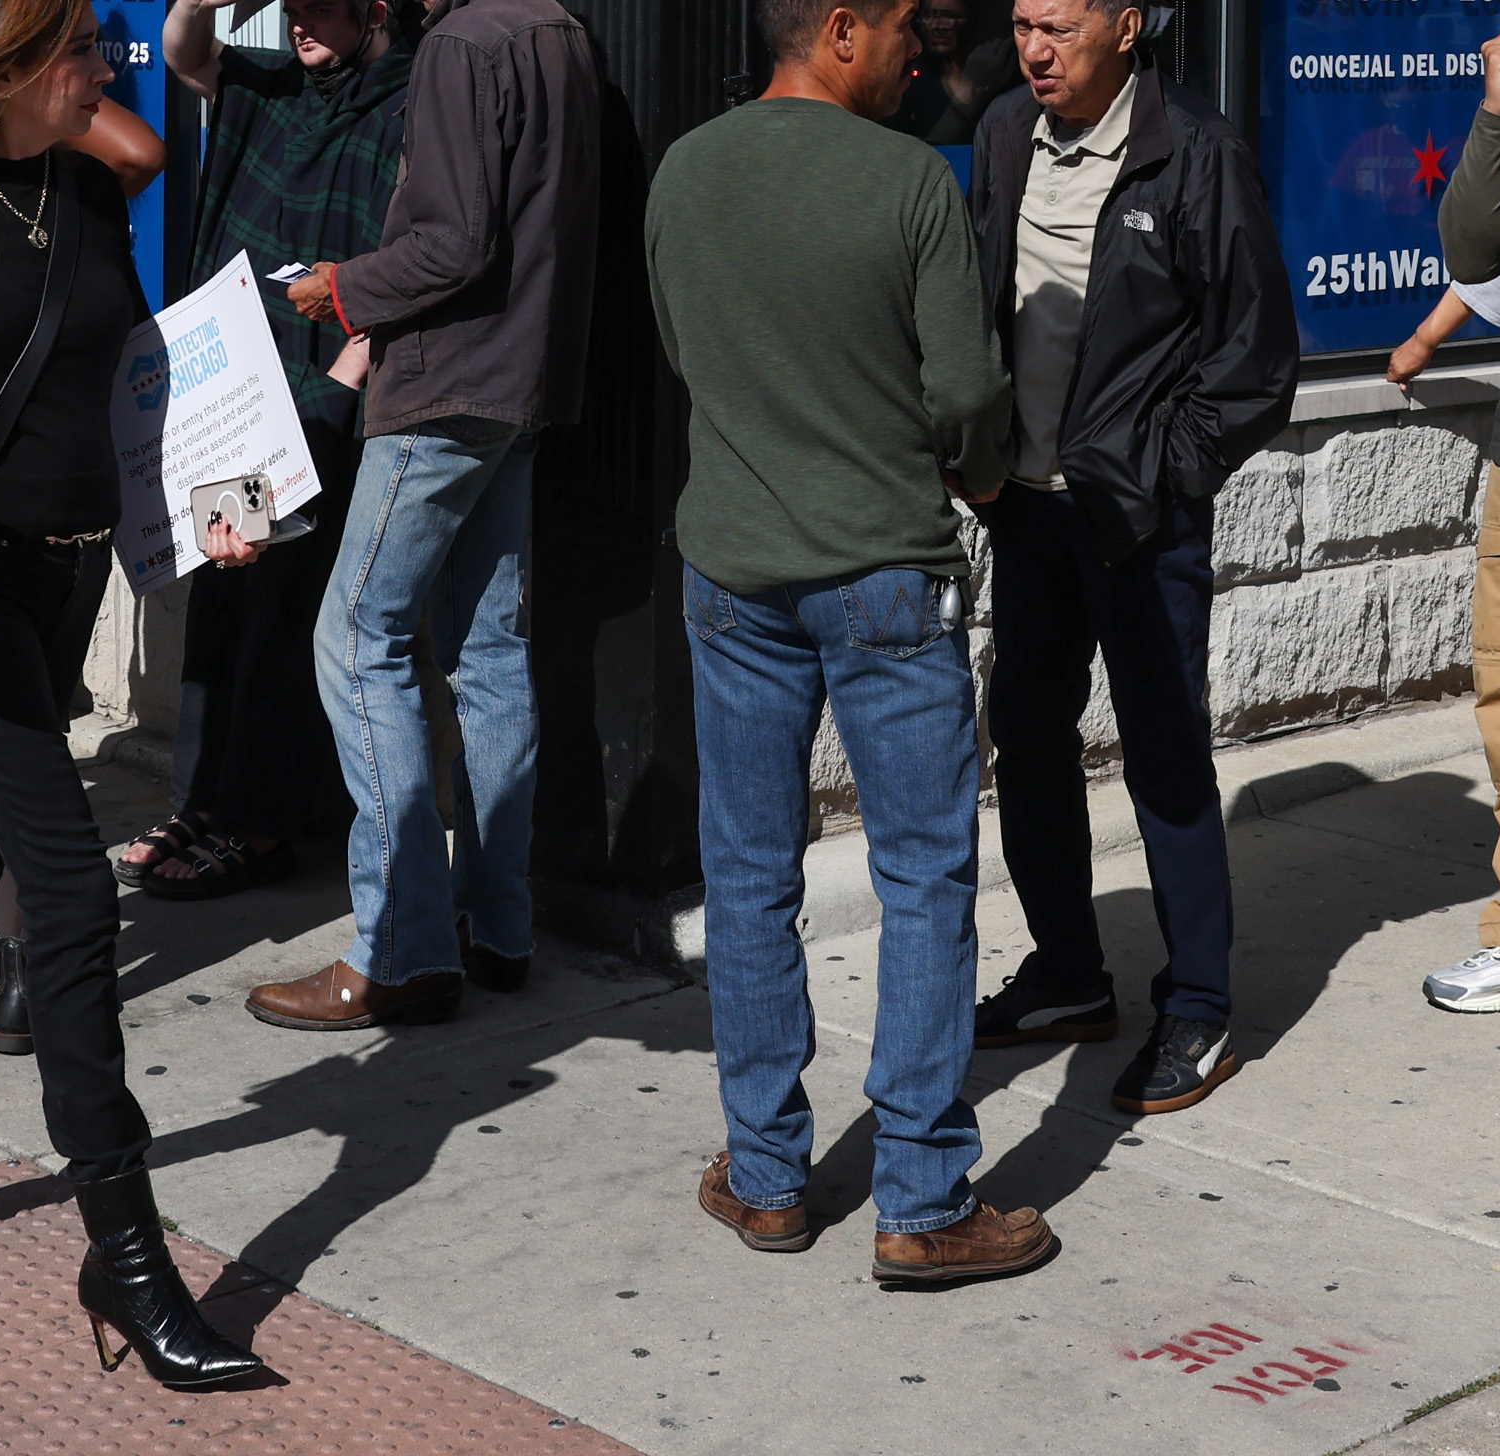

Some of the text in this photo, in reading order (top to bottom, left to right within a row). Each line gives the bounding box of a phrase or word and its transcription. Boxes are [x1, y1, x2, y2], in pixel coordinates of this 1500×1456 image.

[129, 42, 150, 64] 25
[1289, 54, 1395, 79] CONCEJAL
[1402, 54, 1439, 77] DEL
[155, 315, 220, 370] PROTECTING
[164, 339, 229, 400] CHICAGO
[120, 371, 260, 464] The person or entity that displays this
[128, 389, 265, 480] sign does so voluntarily and assumes
[145, 411, 263, 489] any and all risks associated with
[177, 442, 249, 491] displaying this sign.
[268, 445, 289, 463] advice.
[141, 512, 180, 540] This sign
[156, 540, 185, 566] CHICAGO
[1140, 1322, 1264, 1373] ICE
